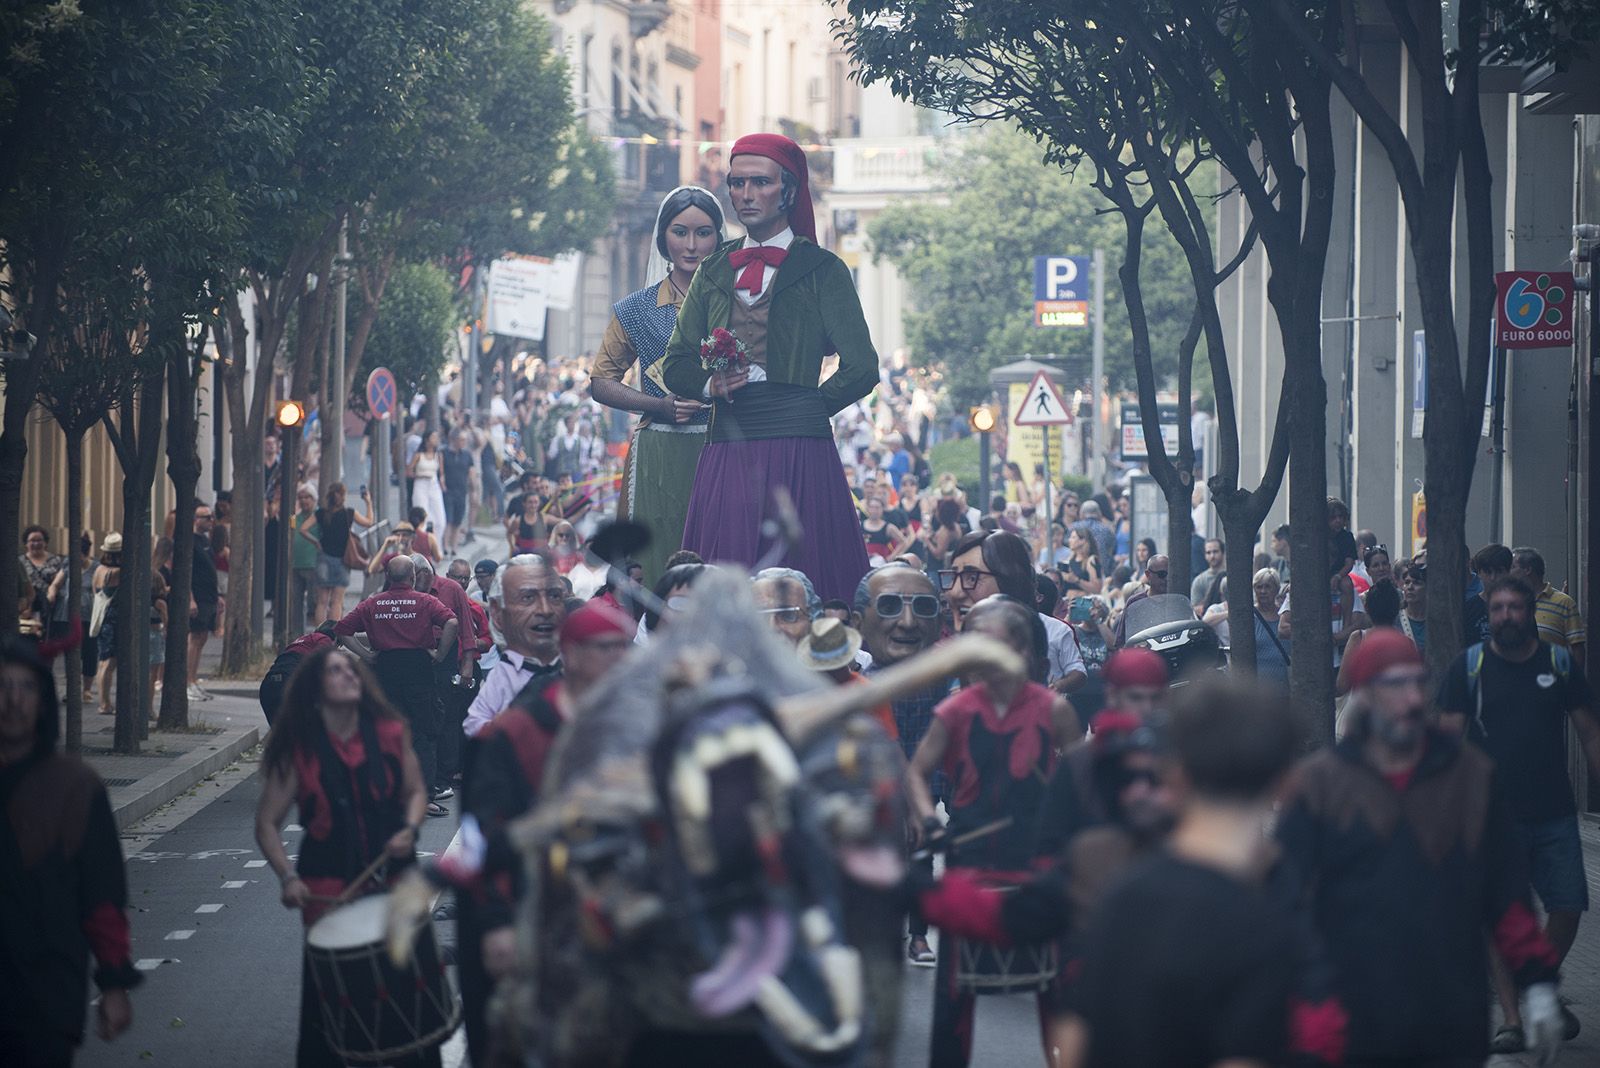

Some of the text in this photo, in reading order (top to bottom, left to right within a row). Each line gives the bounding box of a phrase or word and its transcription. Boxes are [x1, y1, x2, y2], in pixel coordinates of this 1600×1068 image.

[1046, 257, 1078, 300] P
[1502, 330, 1571, 341] EURO 6000
[394, 612, 417, 620] CUGAT
